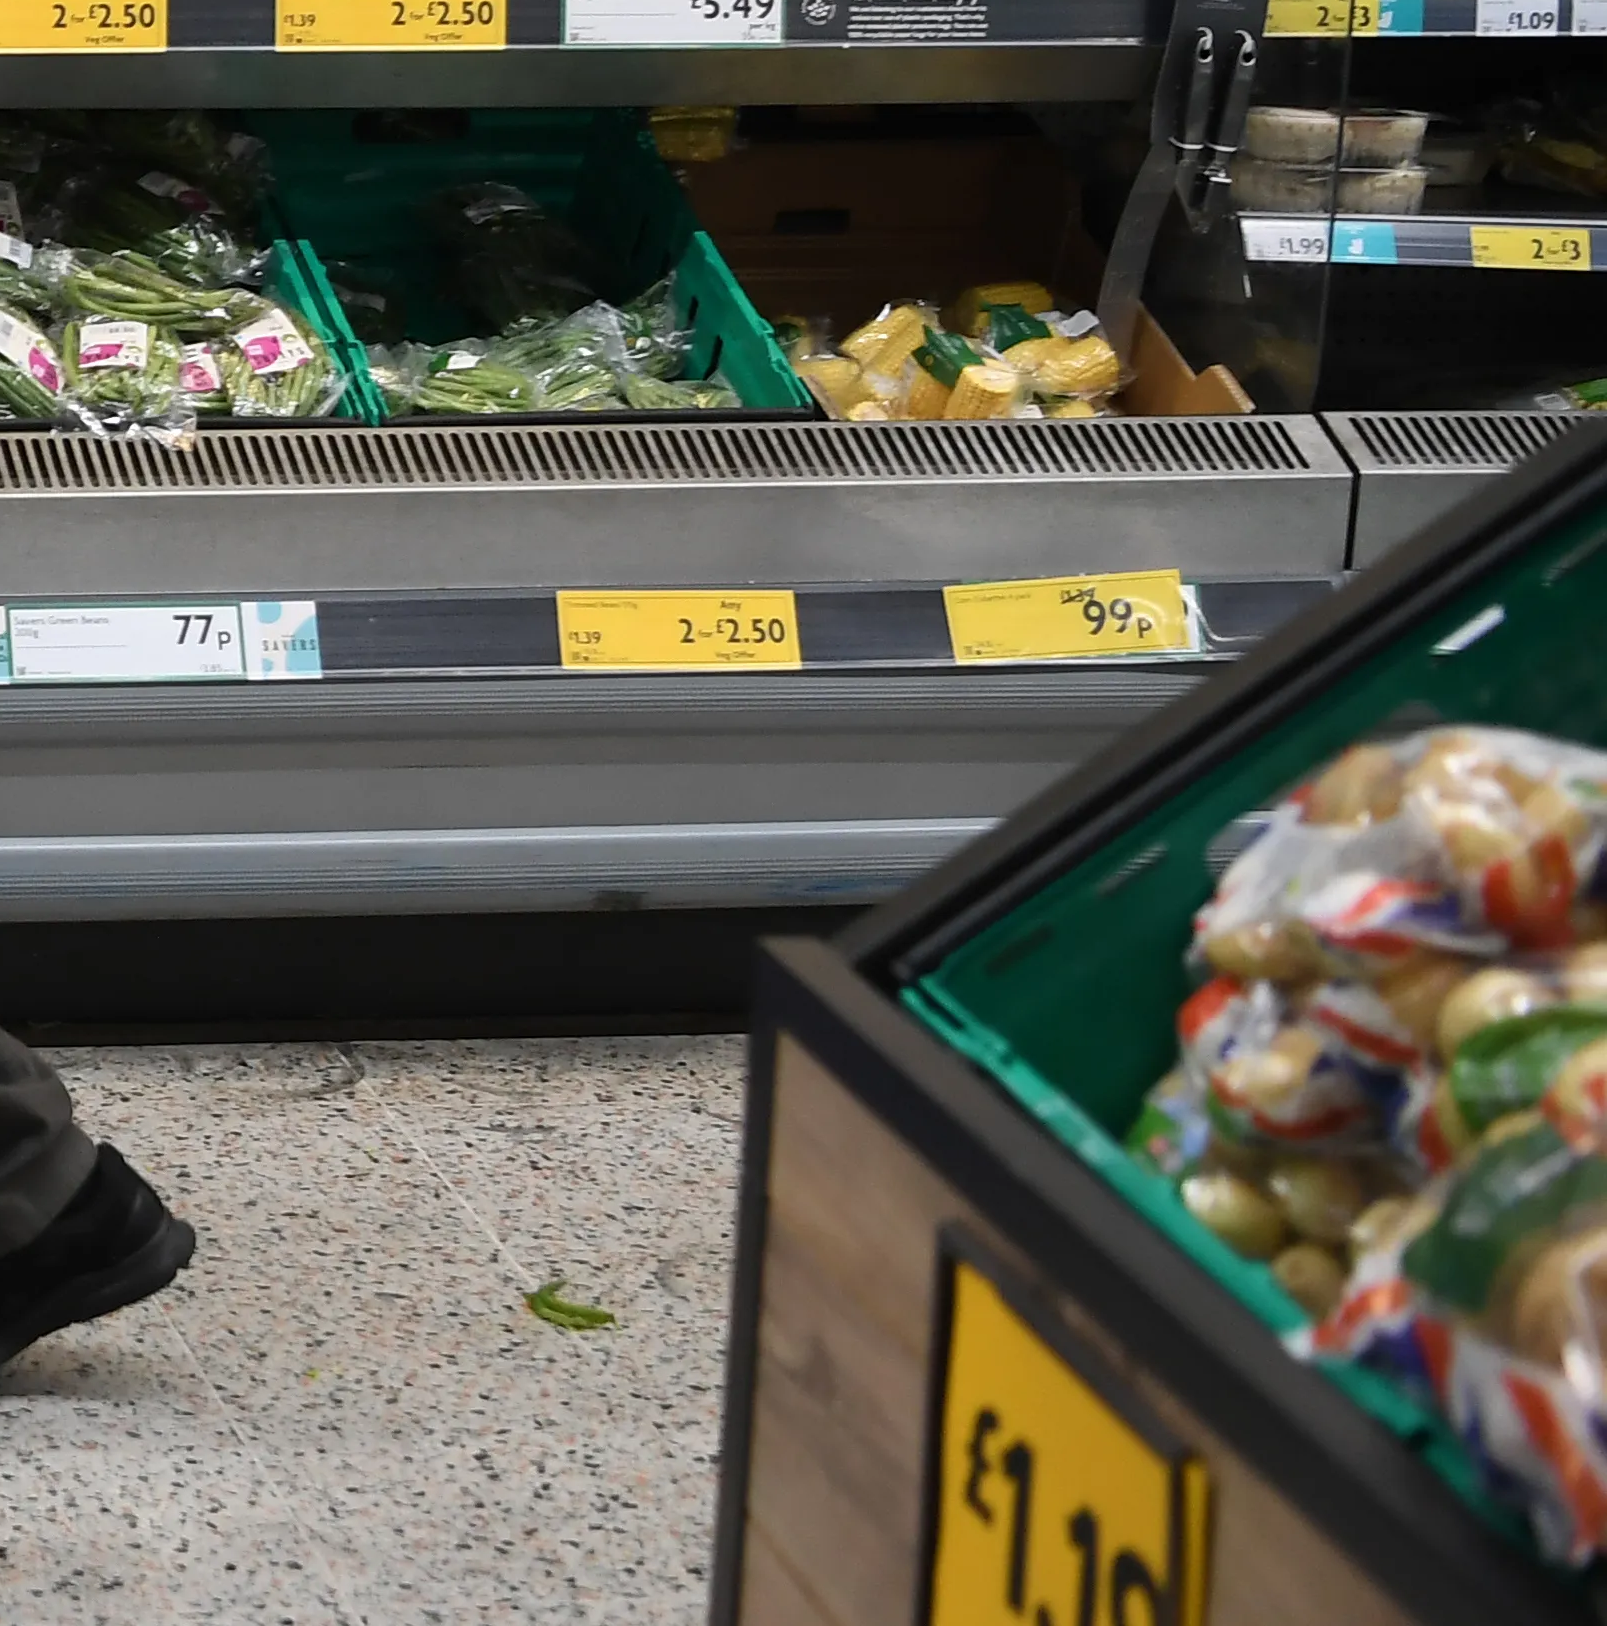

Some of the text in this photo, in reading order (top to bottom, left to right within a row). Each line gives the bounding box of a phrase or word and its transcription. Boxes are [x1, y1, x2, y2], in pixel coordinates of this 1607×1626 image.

[52, 4, 155, 28] 2 £2.50
[284, 15, 317, 27] £1.39
[391, 1, 493, 25] 2 £2.50
[1316, 4, 1330, 27] 2
[1508, 10, 1555, 31] £1.09
[1530, 238, 1581, 260] 2 £3
[1081, 596, 1152, 638] 99p
[173, 615, 231, 650] 77p
[569, 631, 602, 643] £1.39
[679, 619, 785, 643] 2 £2.50
[262, 639, 317, 652] SAVERS
